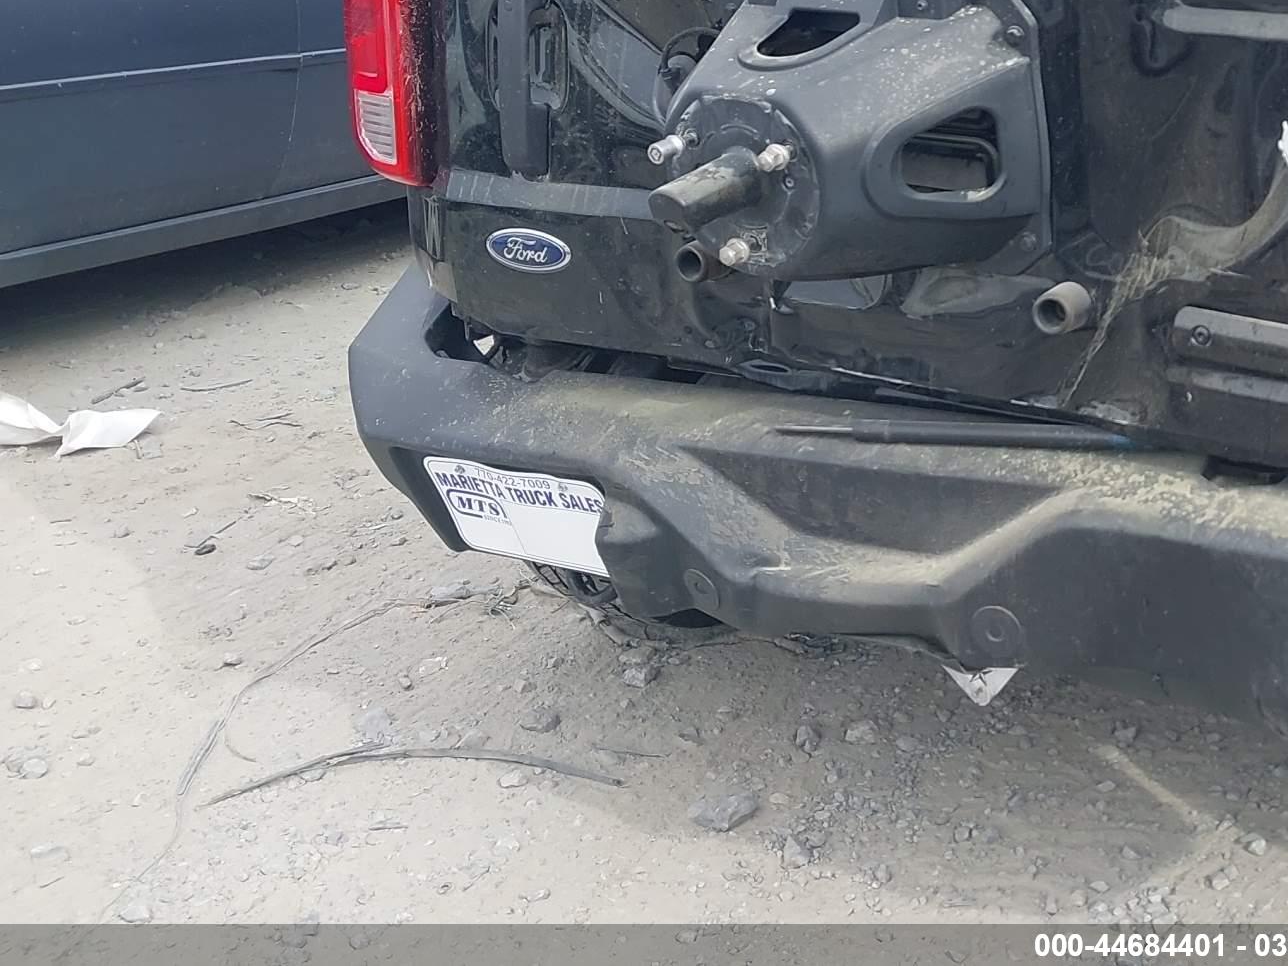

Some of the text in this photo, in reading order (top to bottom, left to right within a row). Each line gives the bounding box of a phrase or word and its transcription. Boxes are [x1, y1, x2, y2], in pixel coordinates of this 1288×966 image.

[503, 237, 548, 263] Ford
[474, 467, 551, 490] 770-422-7009
[434, 472, 603, 515] MARIETTA TRUCK SALES
[456, 495, 500, 516] MTS
